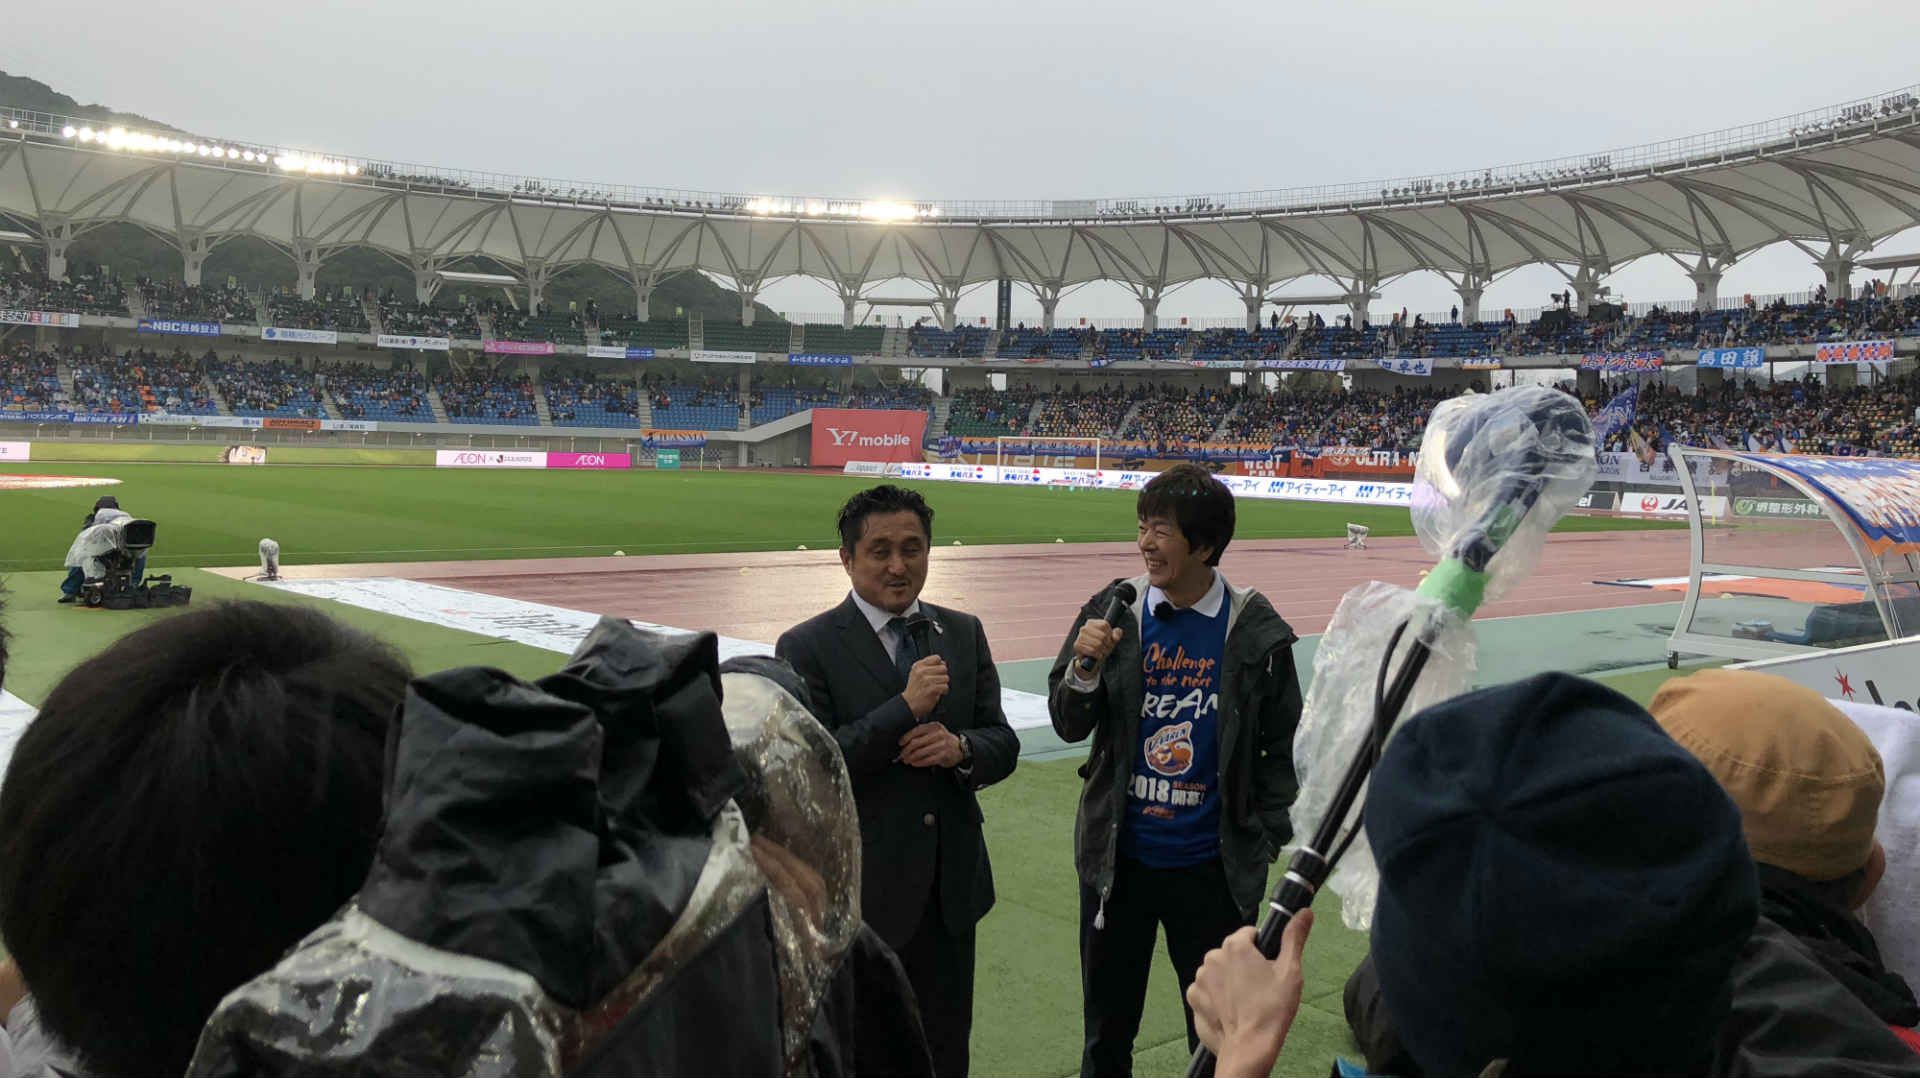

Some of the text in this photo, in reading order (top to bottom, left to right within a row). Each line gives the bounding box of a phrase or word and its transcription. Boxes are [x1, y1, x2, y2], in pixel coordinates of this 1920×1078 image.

[575, 455, 605, 465] AEON
[1286, 481, 1347, 494] アイティーアイ
[1143, 643, 1216, 678] Challenge
[1140, 688, 1219, 719] REA
